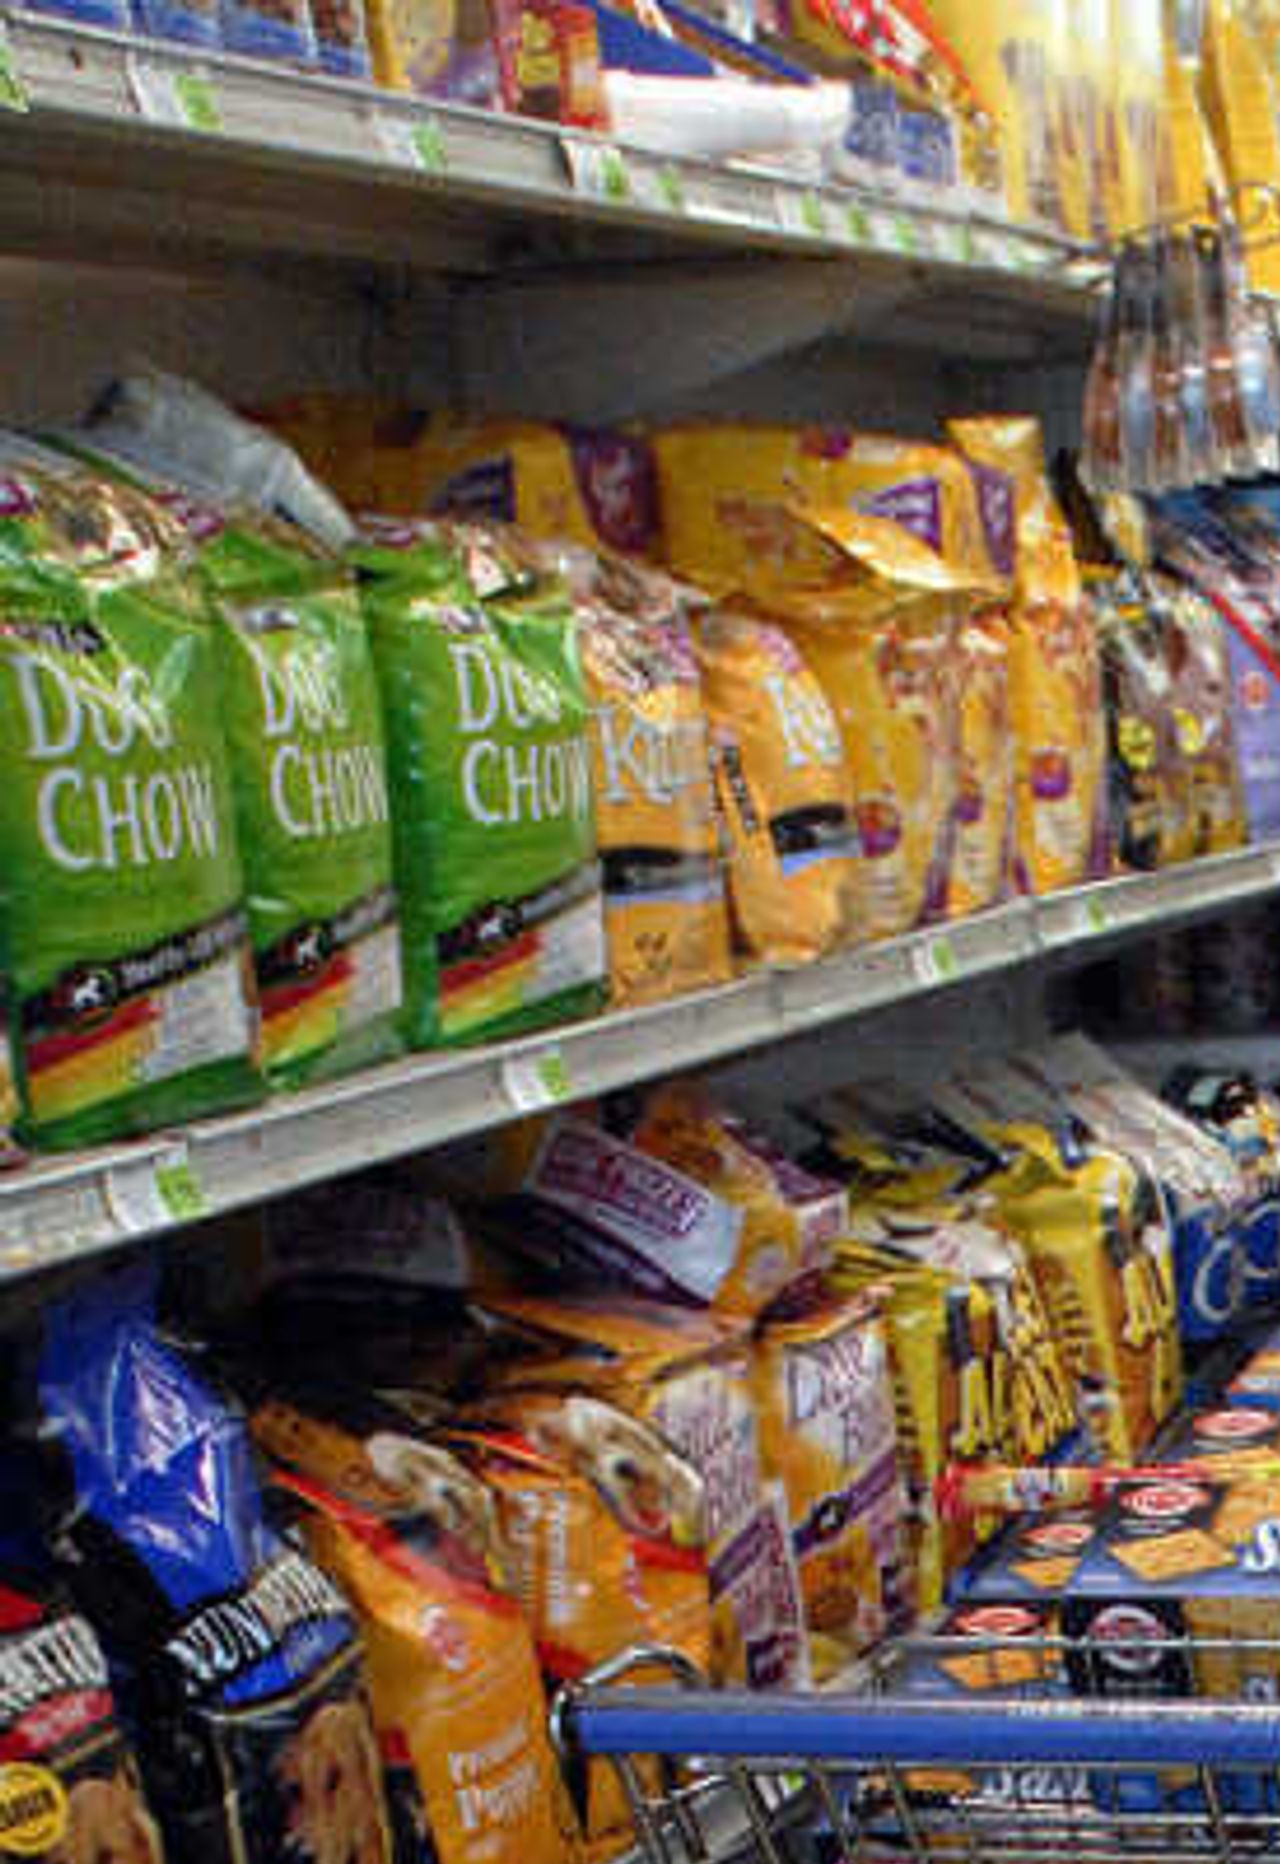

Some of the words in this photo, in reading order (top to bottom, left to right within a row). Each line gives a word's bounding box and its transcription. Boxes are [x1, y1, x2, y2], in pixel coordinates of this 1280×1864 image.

[38, 767, 218, 872] CHOW
[270, 744, 389, 837] CHOW
[462, 738, 592, 824] CHOW
